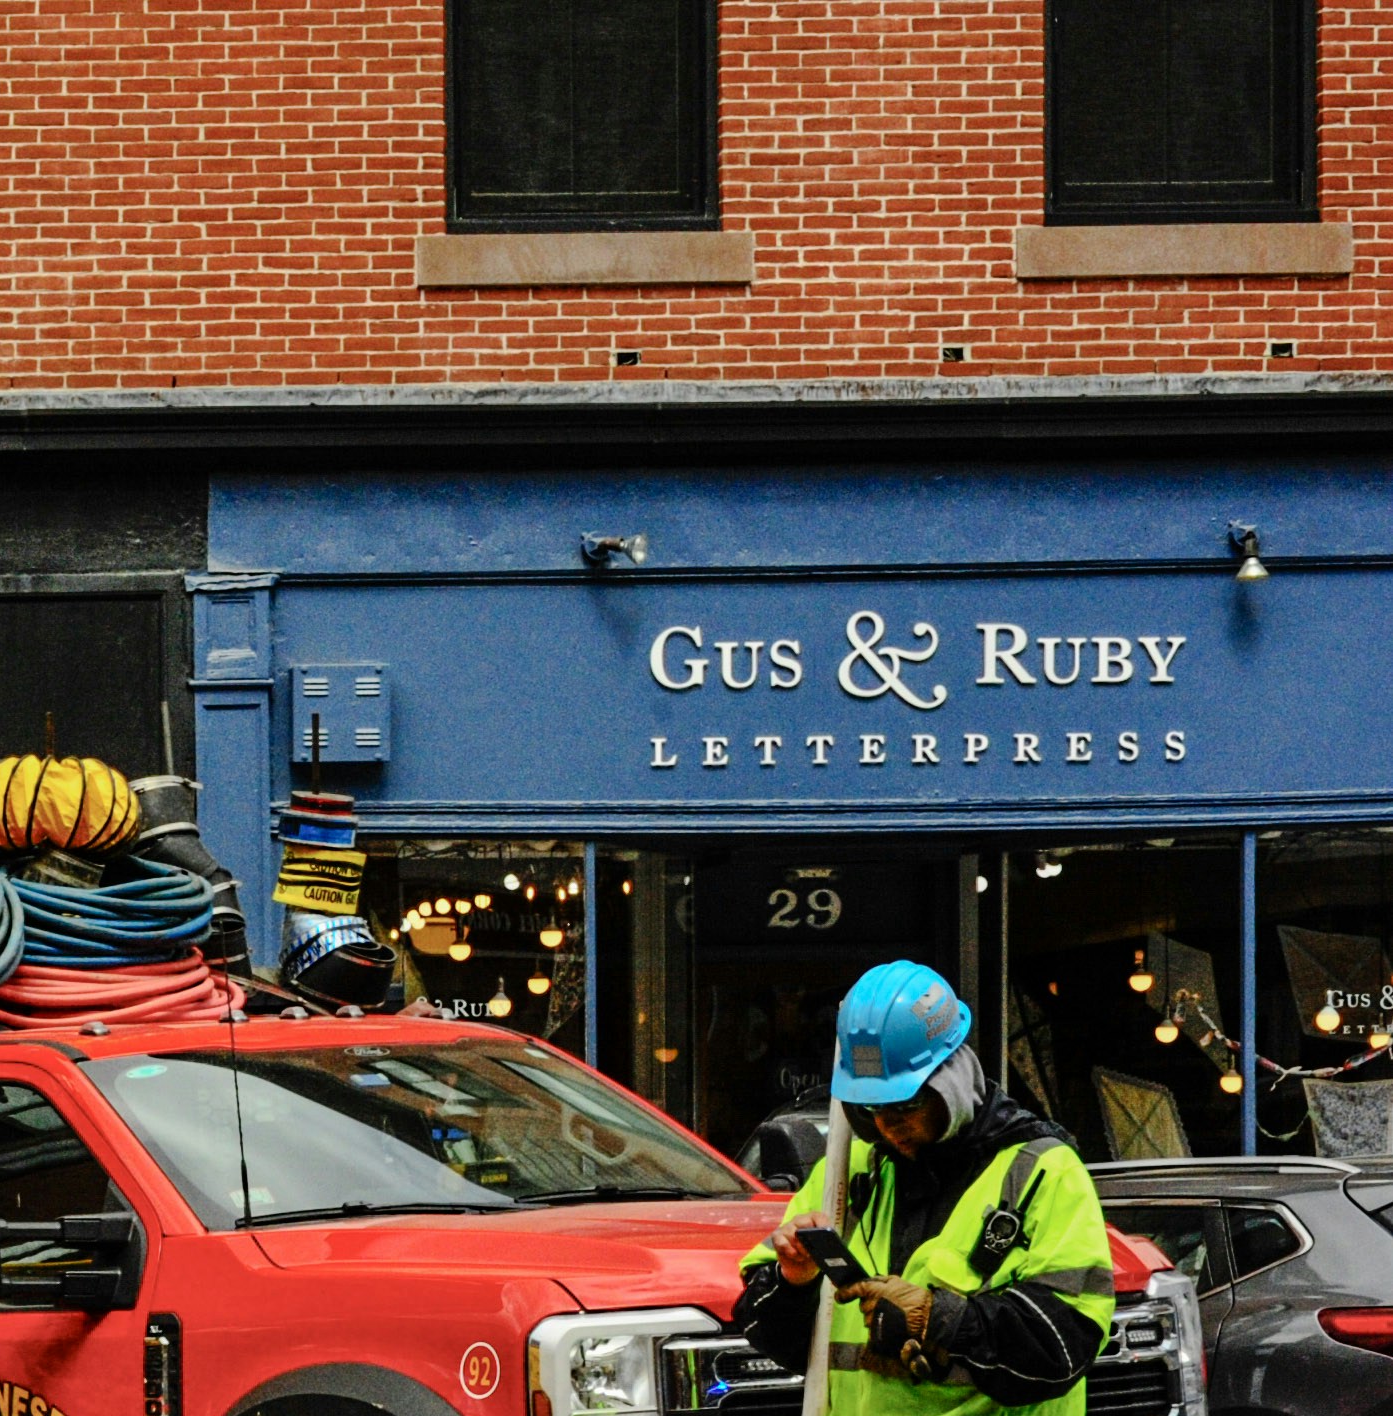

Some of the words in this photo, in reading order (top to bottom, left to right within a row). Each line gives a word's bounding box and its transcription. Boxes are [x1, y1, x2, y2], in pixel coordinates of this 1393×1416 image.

[837, 609, 948, 710] &
[650, 730, 1188, 768] LETTERPRESS
[303, 885, 344, 904] CAUTION
[767, 888, 842, 929] 29
[468, 1355, 491, 1387] 92
